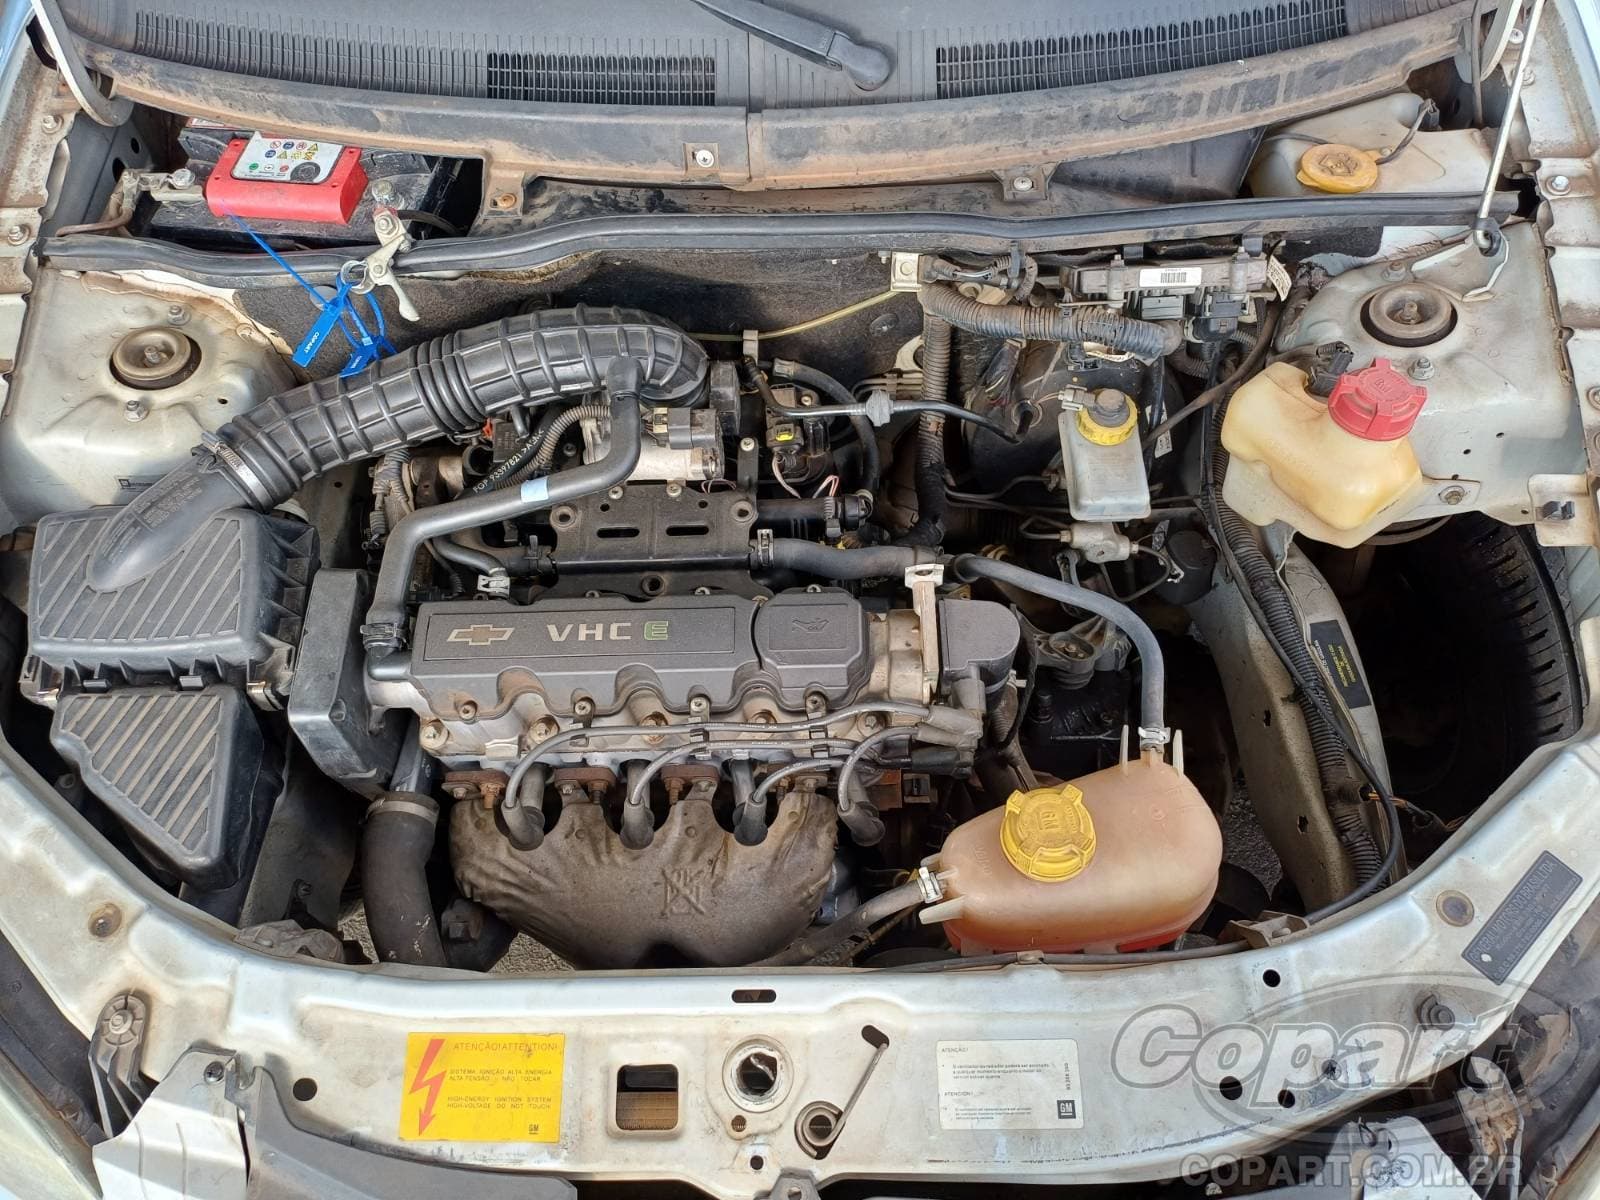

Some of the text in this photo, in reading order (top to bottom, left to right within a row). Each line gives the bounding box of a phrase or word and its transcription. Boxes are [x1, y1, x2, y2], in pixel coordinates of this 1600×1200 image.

[547, 621, 669, 642] VHC E
[1060, 1102, 1073, 1112] GM
[528, 1123, 540, 1132] GM
